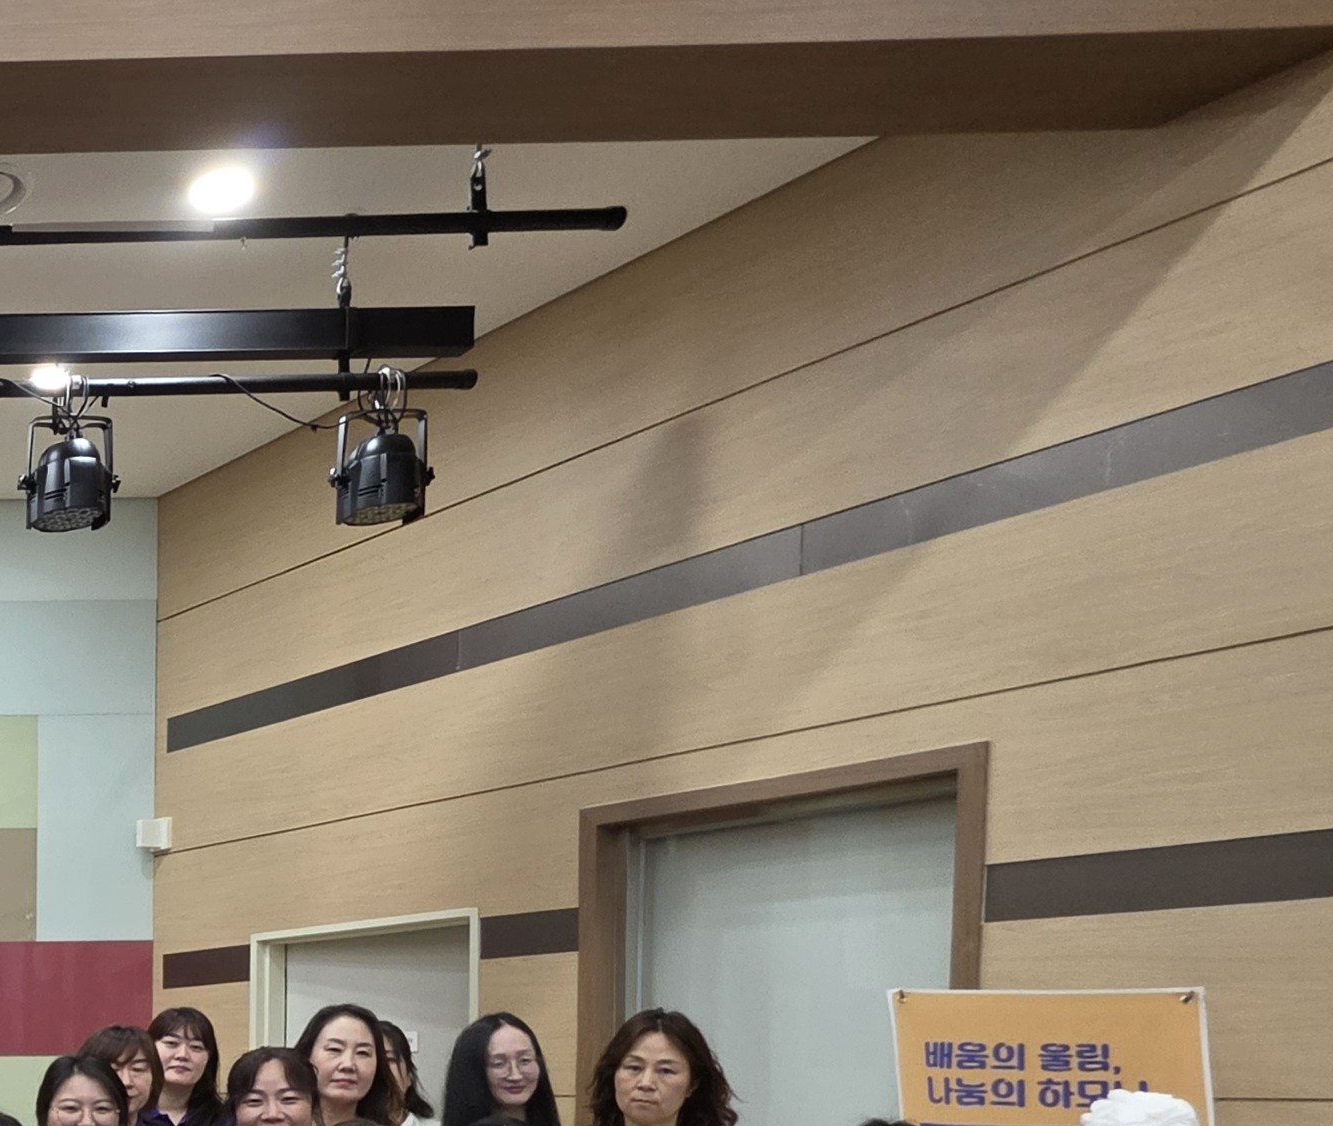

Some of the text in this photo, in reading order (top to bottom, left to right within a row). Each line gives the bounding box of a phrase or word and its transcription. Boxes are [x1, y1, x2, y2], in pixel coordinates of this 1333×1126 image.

[924, 1041, 1122, 1075] 배움의 울림,
[928, 1076, 1148, 1109] 나눔의 하모
